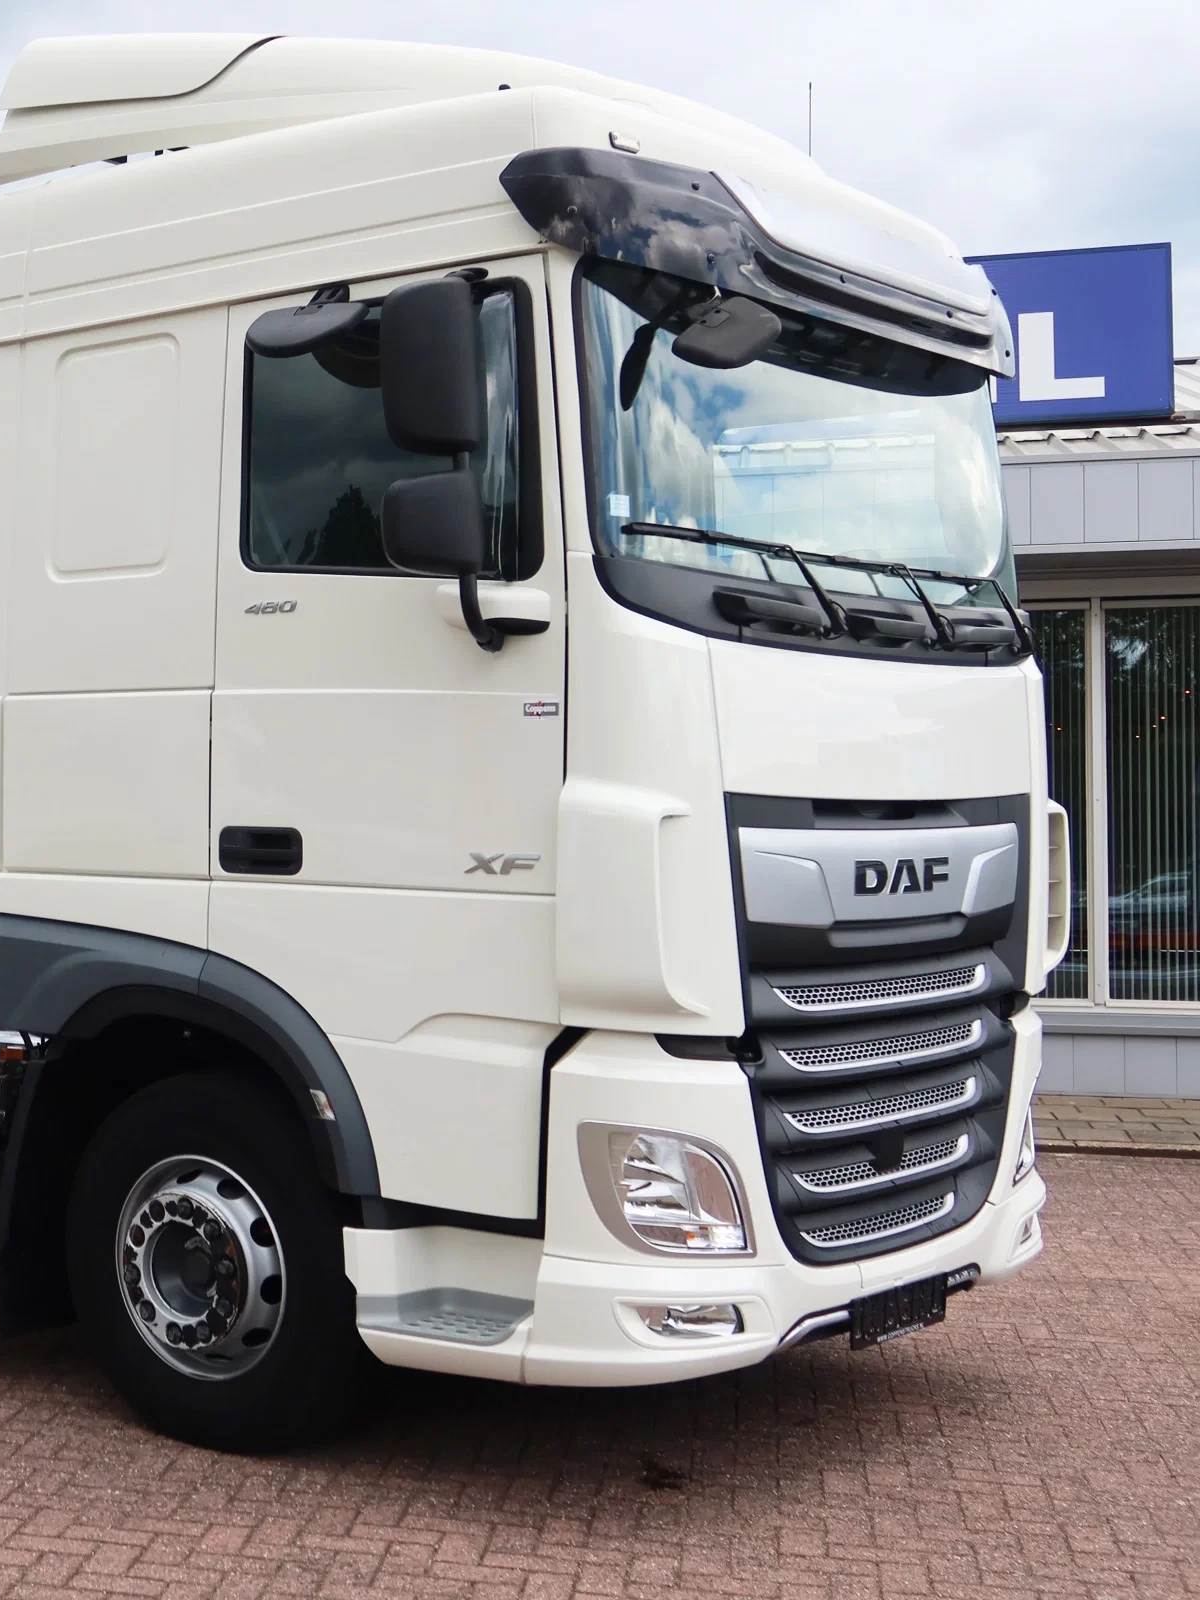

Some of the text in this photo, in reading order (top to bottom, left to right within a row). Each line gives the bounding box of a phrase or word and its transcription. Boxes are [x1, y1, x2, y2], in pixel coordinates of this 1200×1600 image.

[990, 311, 1106, 403] L
[244, 600, 298, 614] 480
[525, 703, 557, 715] Coppens
[463, 852, 542, 876] XF
[853, 856, 950, 896] DAF
